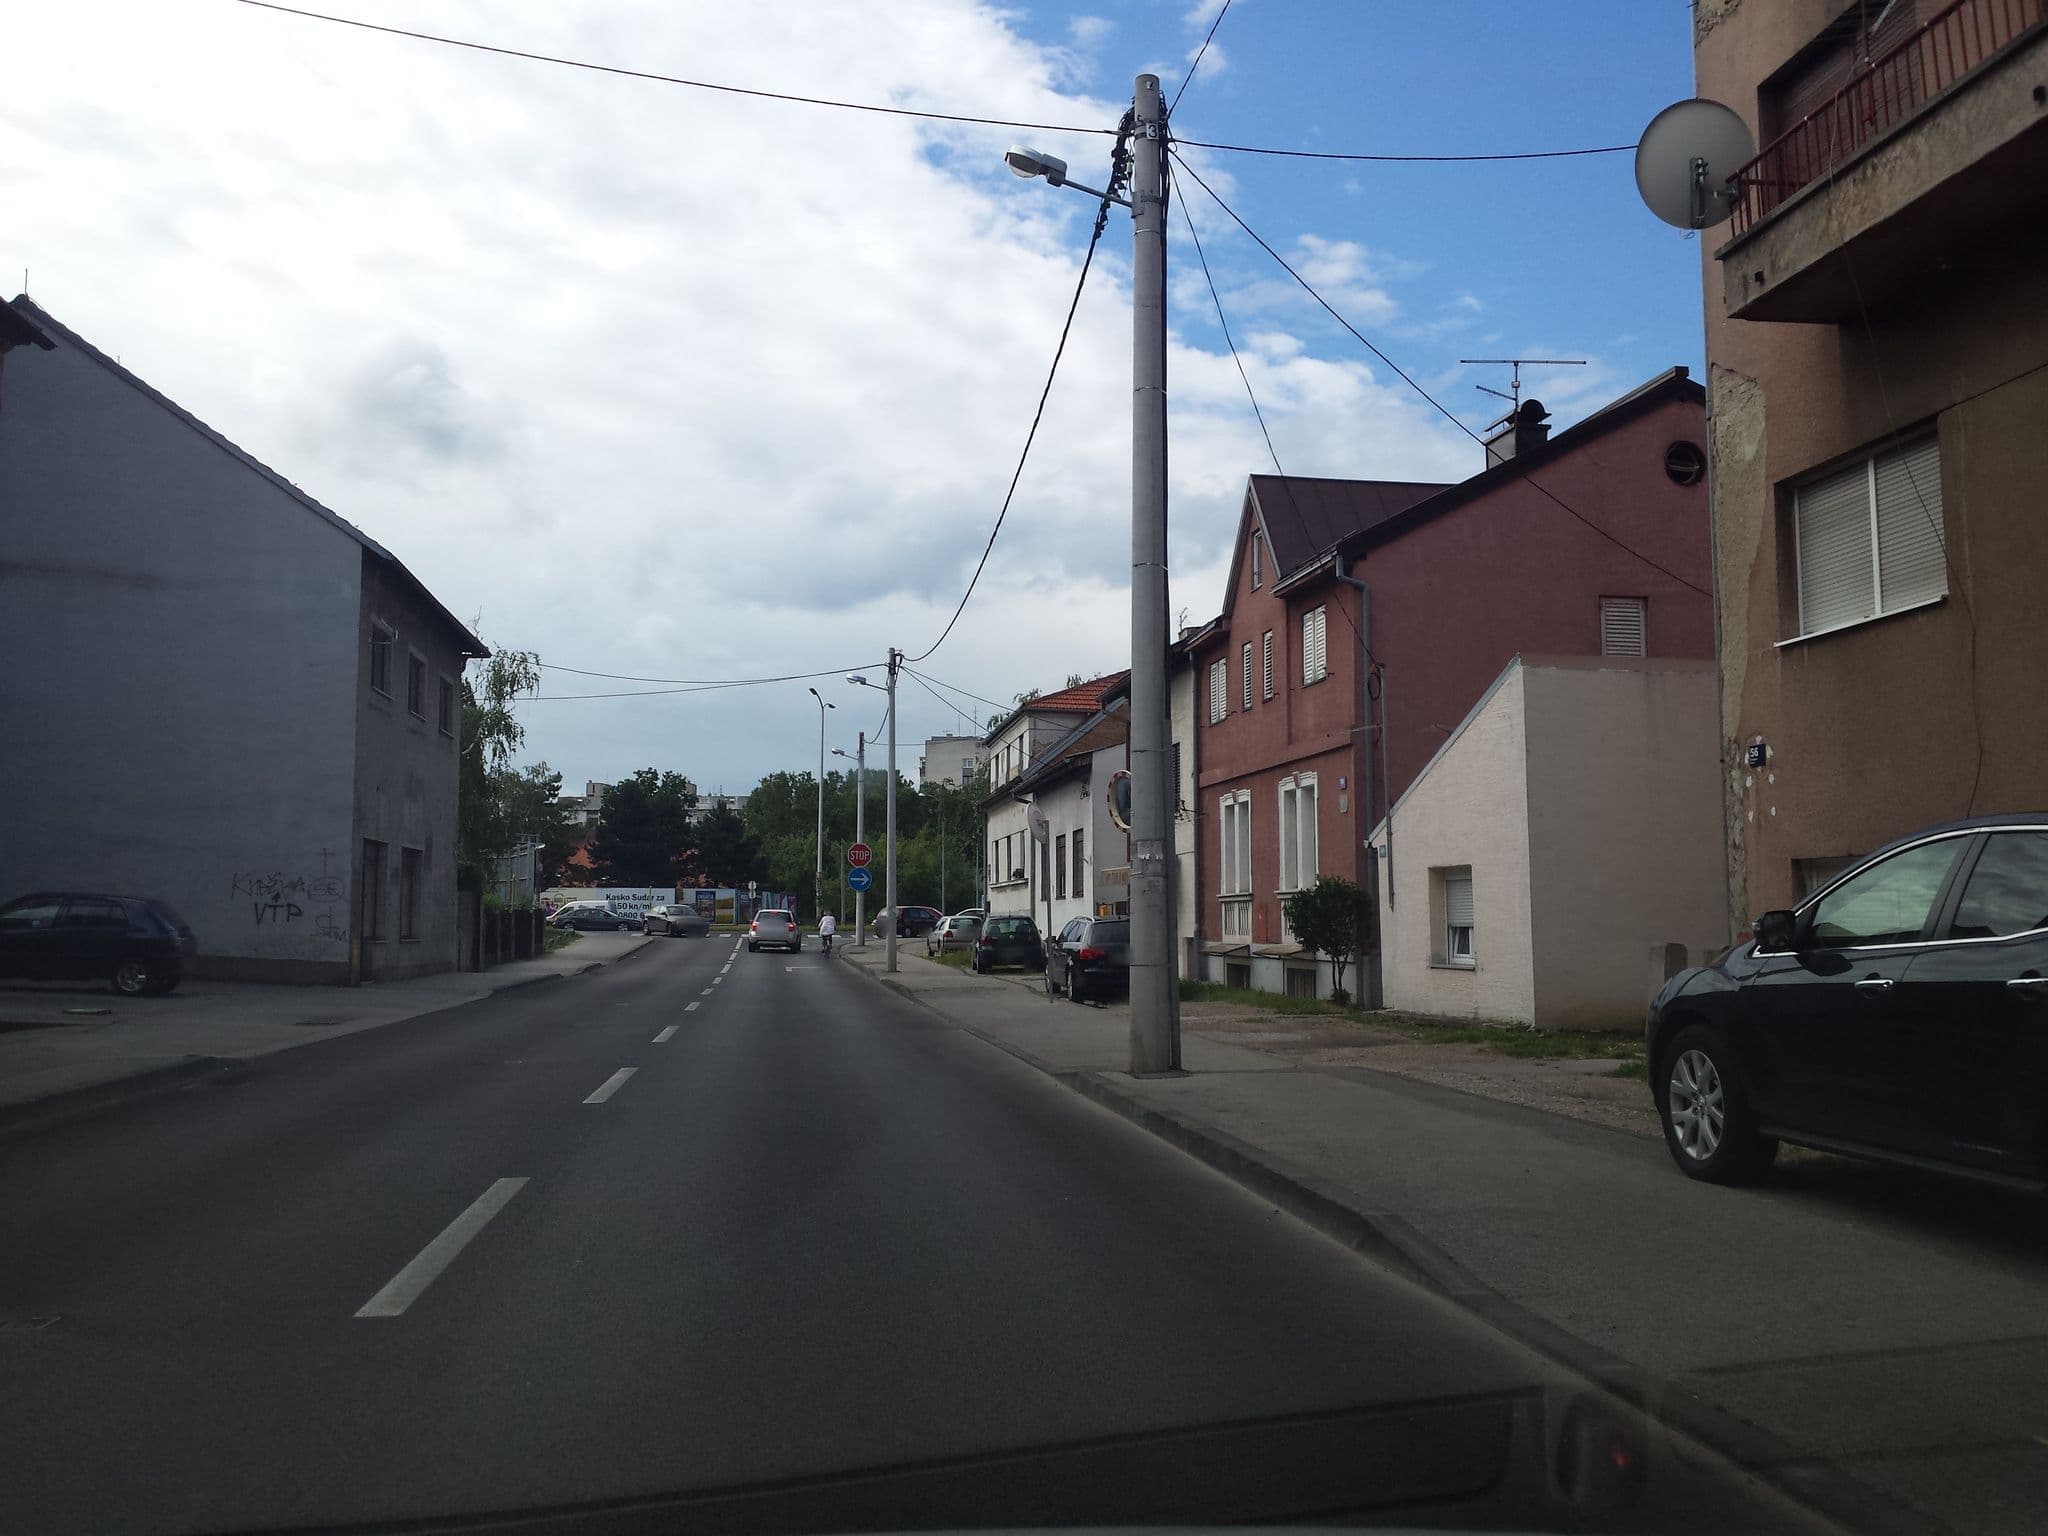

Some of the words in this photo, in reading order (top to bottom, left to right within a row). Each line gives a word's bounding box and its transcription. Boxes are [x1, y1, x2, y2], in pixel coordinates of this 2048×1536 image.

[1147, 124, 1157, 138] 3
[1750, 747, 1759, 757] 56
[850, 850, 870, 860] STOP
[605, 893, 630, 901] Kasko
[631, 893, 654, 901] Sudar
[254, 902, 303, 925] VTP
